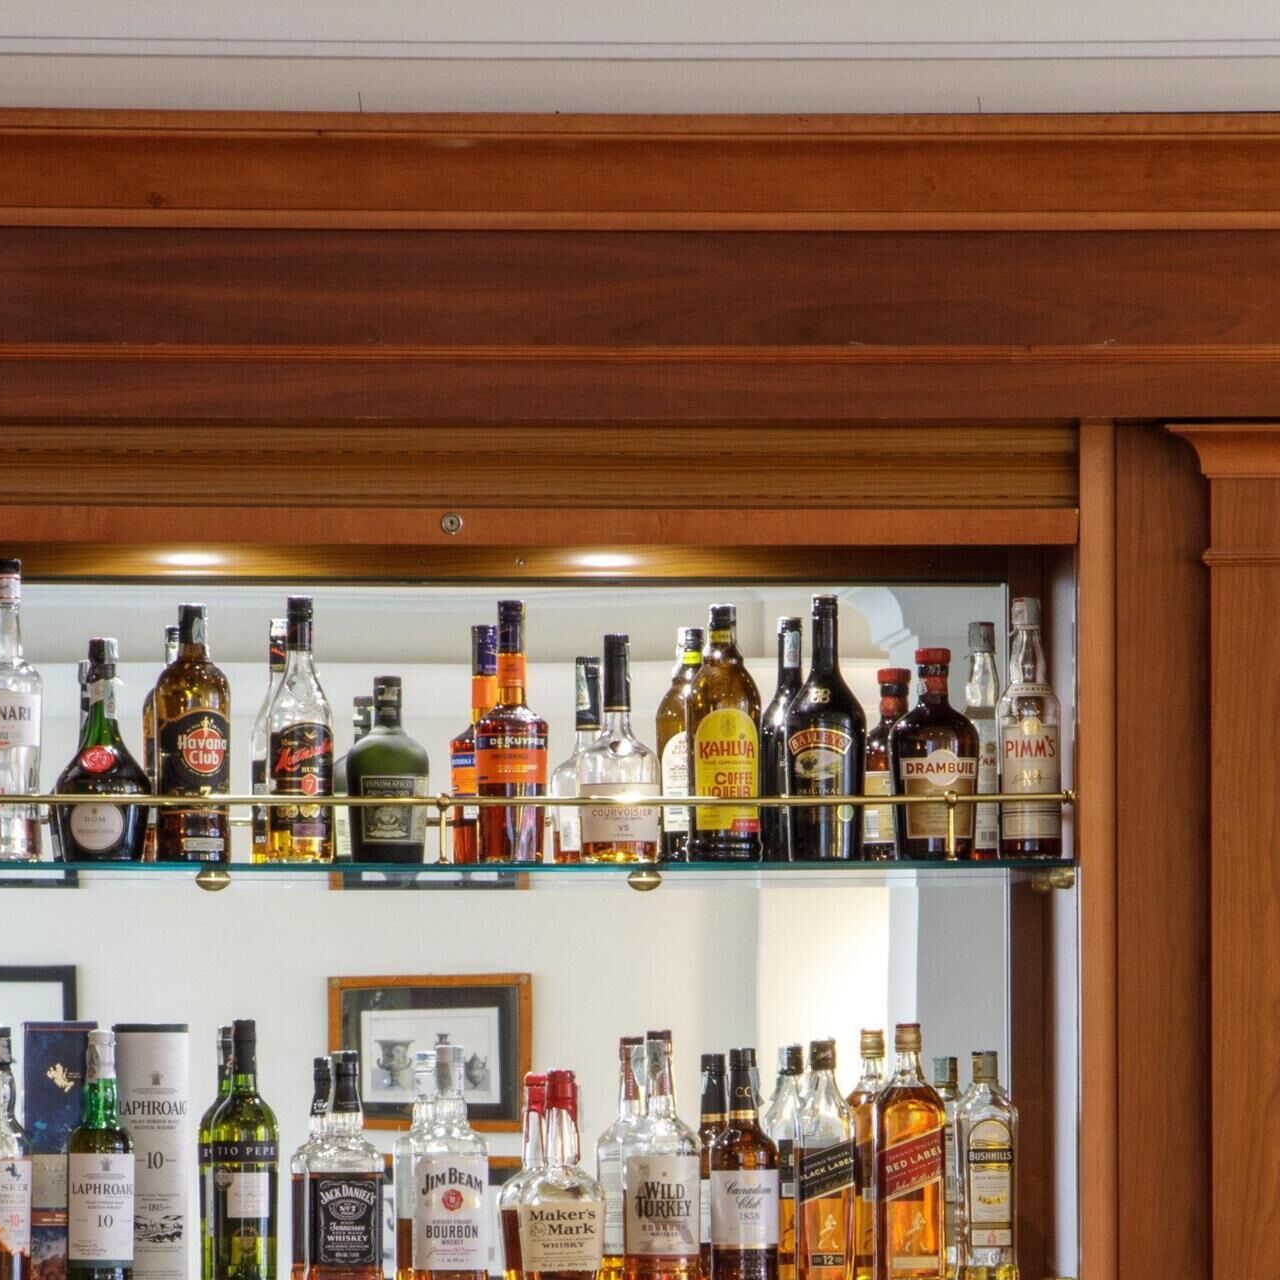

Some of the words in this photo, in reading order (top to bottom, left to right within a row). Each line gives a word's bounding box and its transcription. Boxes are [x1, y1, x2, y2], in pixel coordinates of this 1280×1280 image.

[178, 733, 227, 751] Havana
[791, 731, 847, 750] BAILEYS
[1005, 736, 1056, 759] PIMM'S
[189, 750, 220, 765] Club
[906, 761, 975, 775] DRAMBUIE
[305, 779, 314, 791] 7
[714, 771, 753, 786] COFFEE
[592, 808, 653, 818] COURVOISIER
[119, 1100, 187, 1116] LAPHROAIG
[217, 1146, 239, 1156] TIO
[246, 1146, 275, 1156] PEPE
[969, 1151, 1012, 1161] BUSHMILLS
[147, 1151, 164, 1170] 10
[827, 1157, 855, 1171] LABEL
[885, 1160, 908, 1174] RED
[909, 1146, 942, 1162] LABEL
[422, 1173, 447, 1195] JIM
[448, 1167, 483, 1194] BEAM
[724, 1180, 772, 1195] Canadian
[320, 1188, 342, 1205] JACK
[341, 1184, 376, 1205] DANIEL'S
[645, 1181, 685, 1199] WILD
[148, 1203, 164, 1212] 1815
[635, 1195, 693, 1219] TURKEY
[736, 1196, 763, 1210] Club
[97, 1214, 114, 1229] 10
[529, 1208, 596, 1221] Maker's
[739, 1212, 761, 1221] 1858
[329, 1222, 366, 1232] Tennessee
[426, 1225, 479, 1239] BOURBON
[547, 1223, 596, 1236] Mark
[542, 1241, 585, 1249] WHISKY
[823, 1255, 834, 1265] 12
